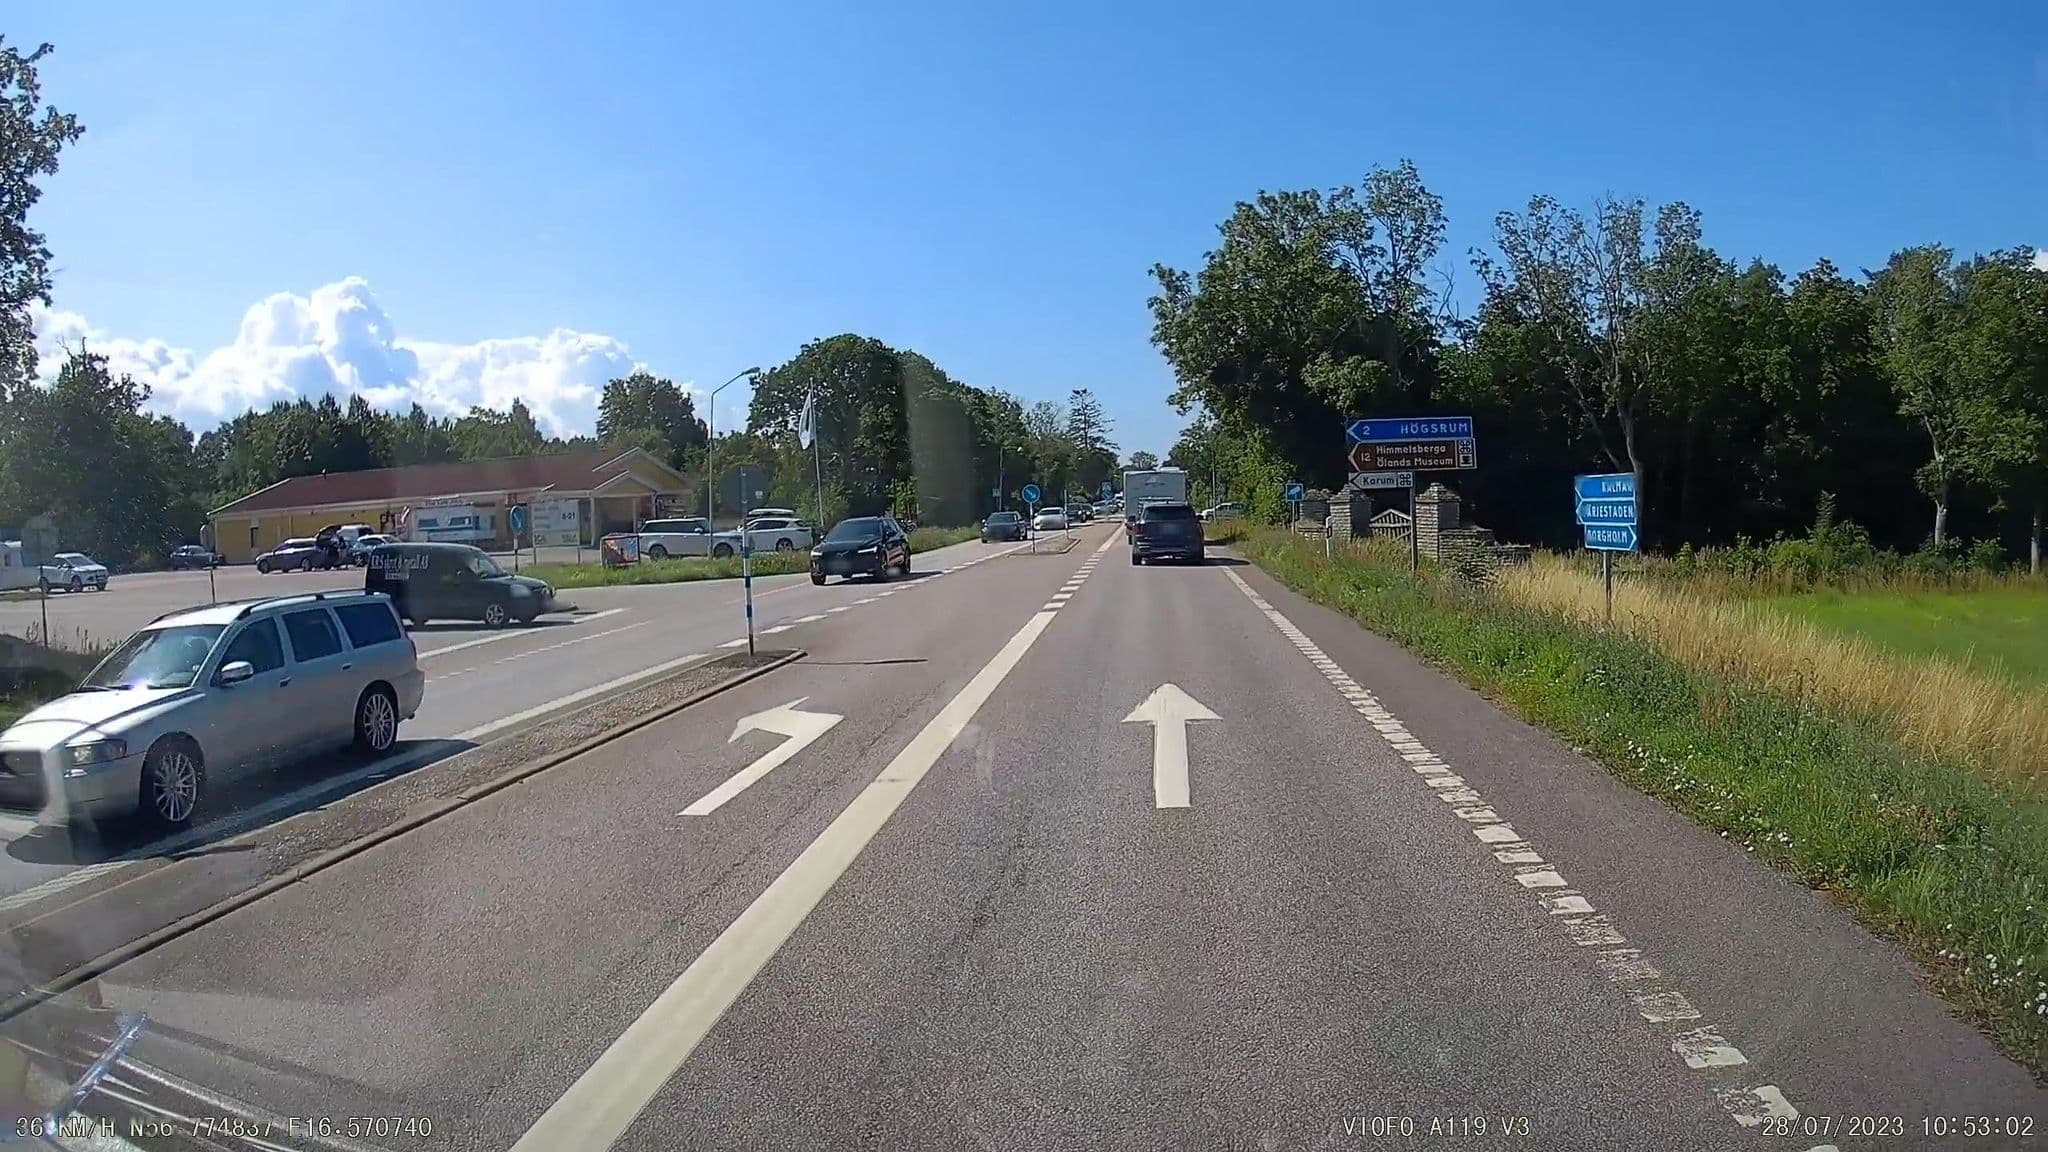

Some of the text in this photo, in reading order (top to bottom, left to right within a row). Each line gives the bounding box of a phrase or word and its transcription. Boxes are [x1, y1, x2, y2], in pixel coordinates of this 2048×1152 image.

[1362, 422, 1469, 436] 2 HÖGSRUM
[1360, 445, 1447, 463] 12 Himmelsberga
[1376, 456, 1454, 468] Ölands Museum
[1362, 476, 1395, 486] Karum
